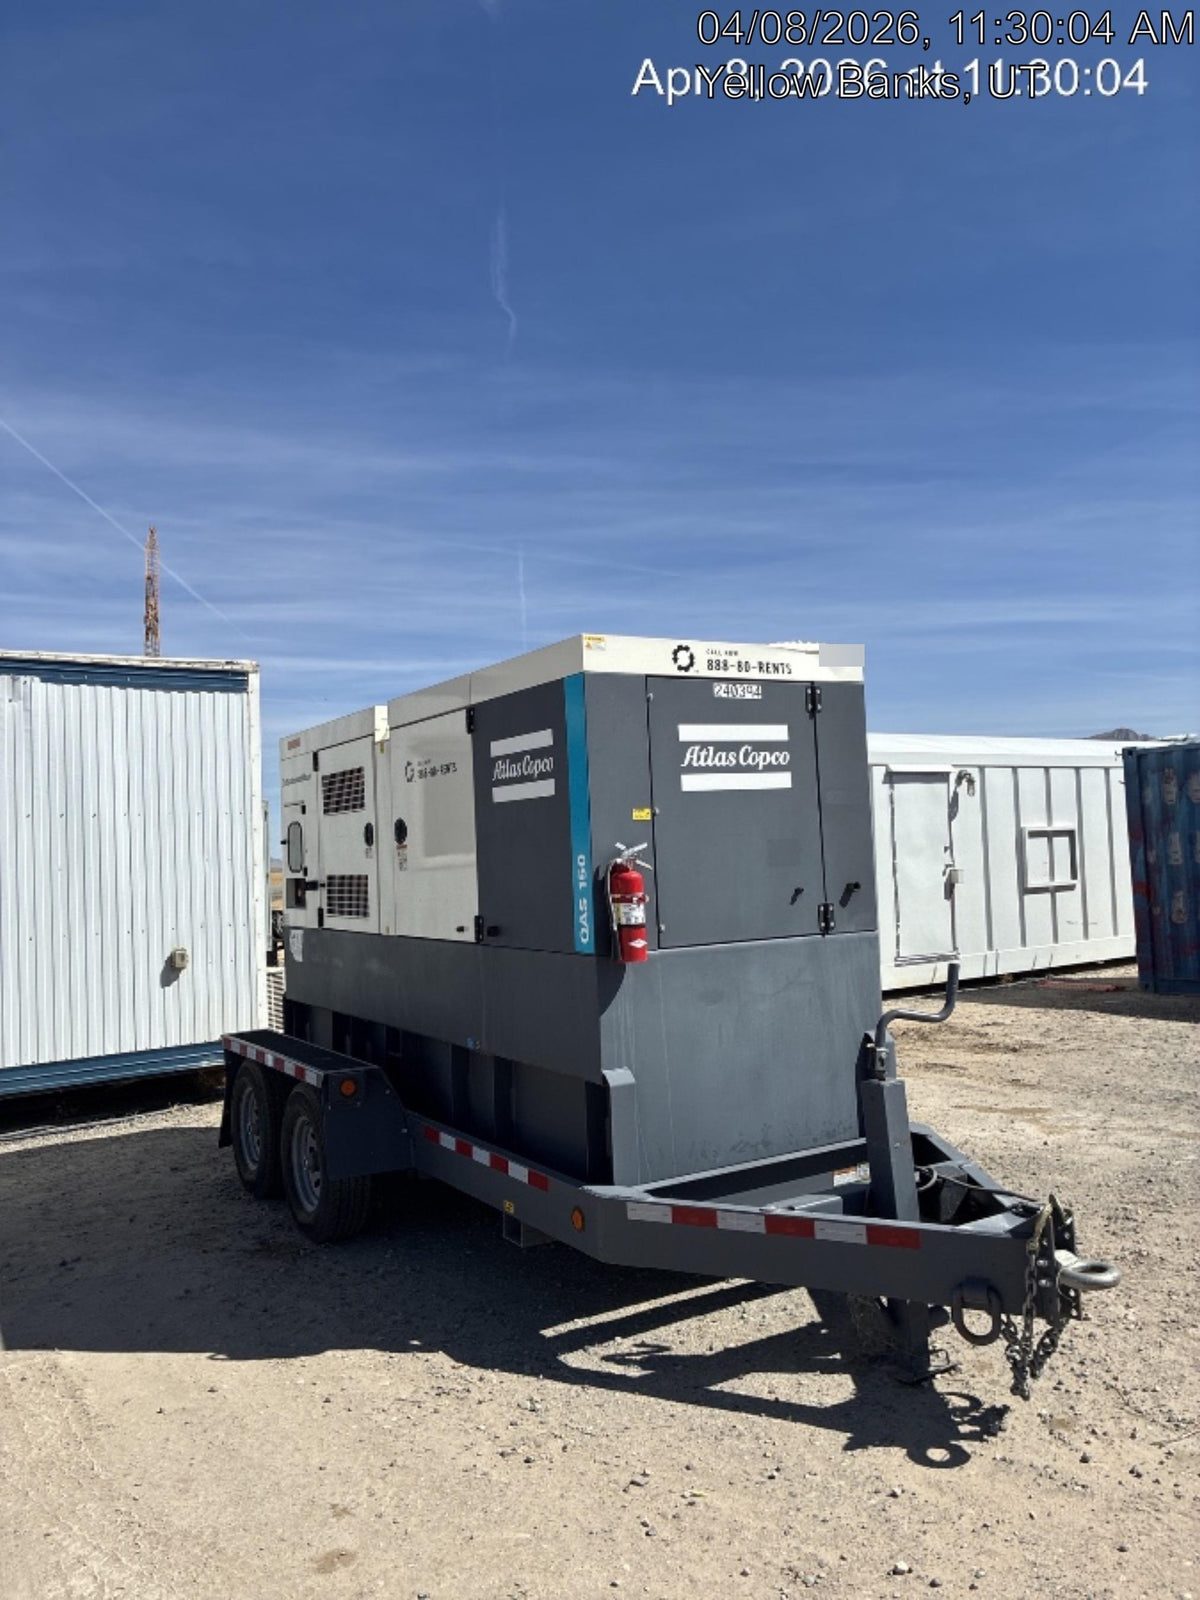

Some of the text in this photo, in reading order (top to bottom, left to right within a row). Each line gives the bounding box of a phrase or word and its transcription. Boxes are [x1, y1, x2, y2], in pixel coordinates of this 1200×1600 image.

[492, 754, 554, 781] Atlas Copco
[680, 744, 790, 770] Atlas Copco
